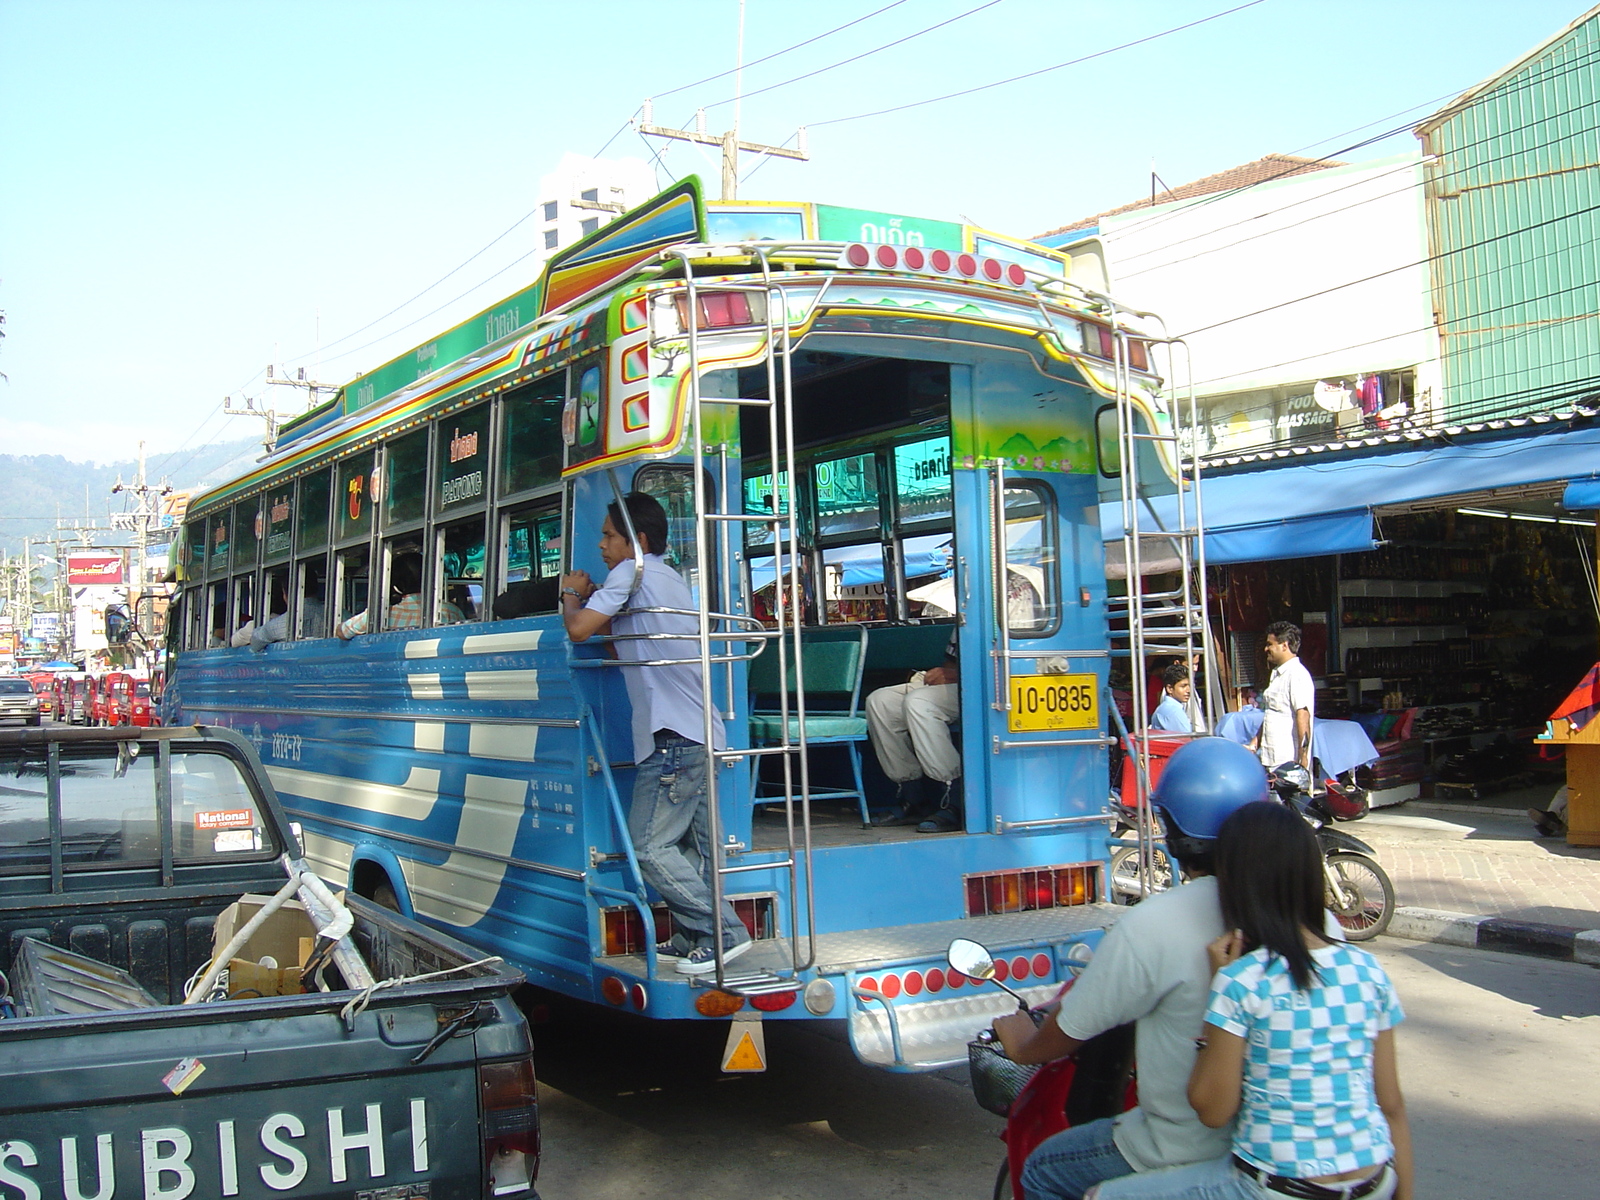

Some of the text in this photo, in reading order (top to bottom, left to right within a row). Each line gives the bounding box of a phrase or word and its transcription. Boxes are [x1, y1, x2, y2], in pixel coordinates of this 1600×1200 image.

[1276, 410, 1334, 429] MASSAGE
[442, 470, 482, 505] PATONG
[1017, 685, 1092, 715] 10-0835
[199, 810, 249, 823] National
